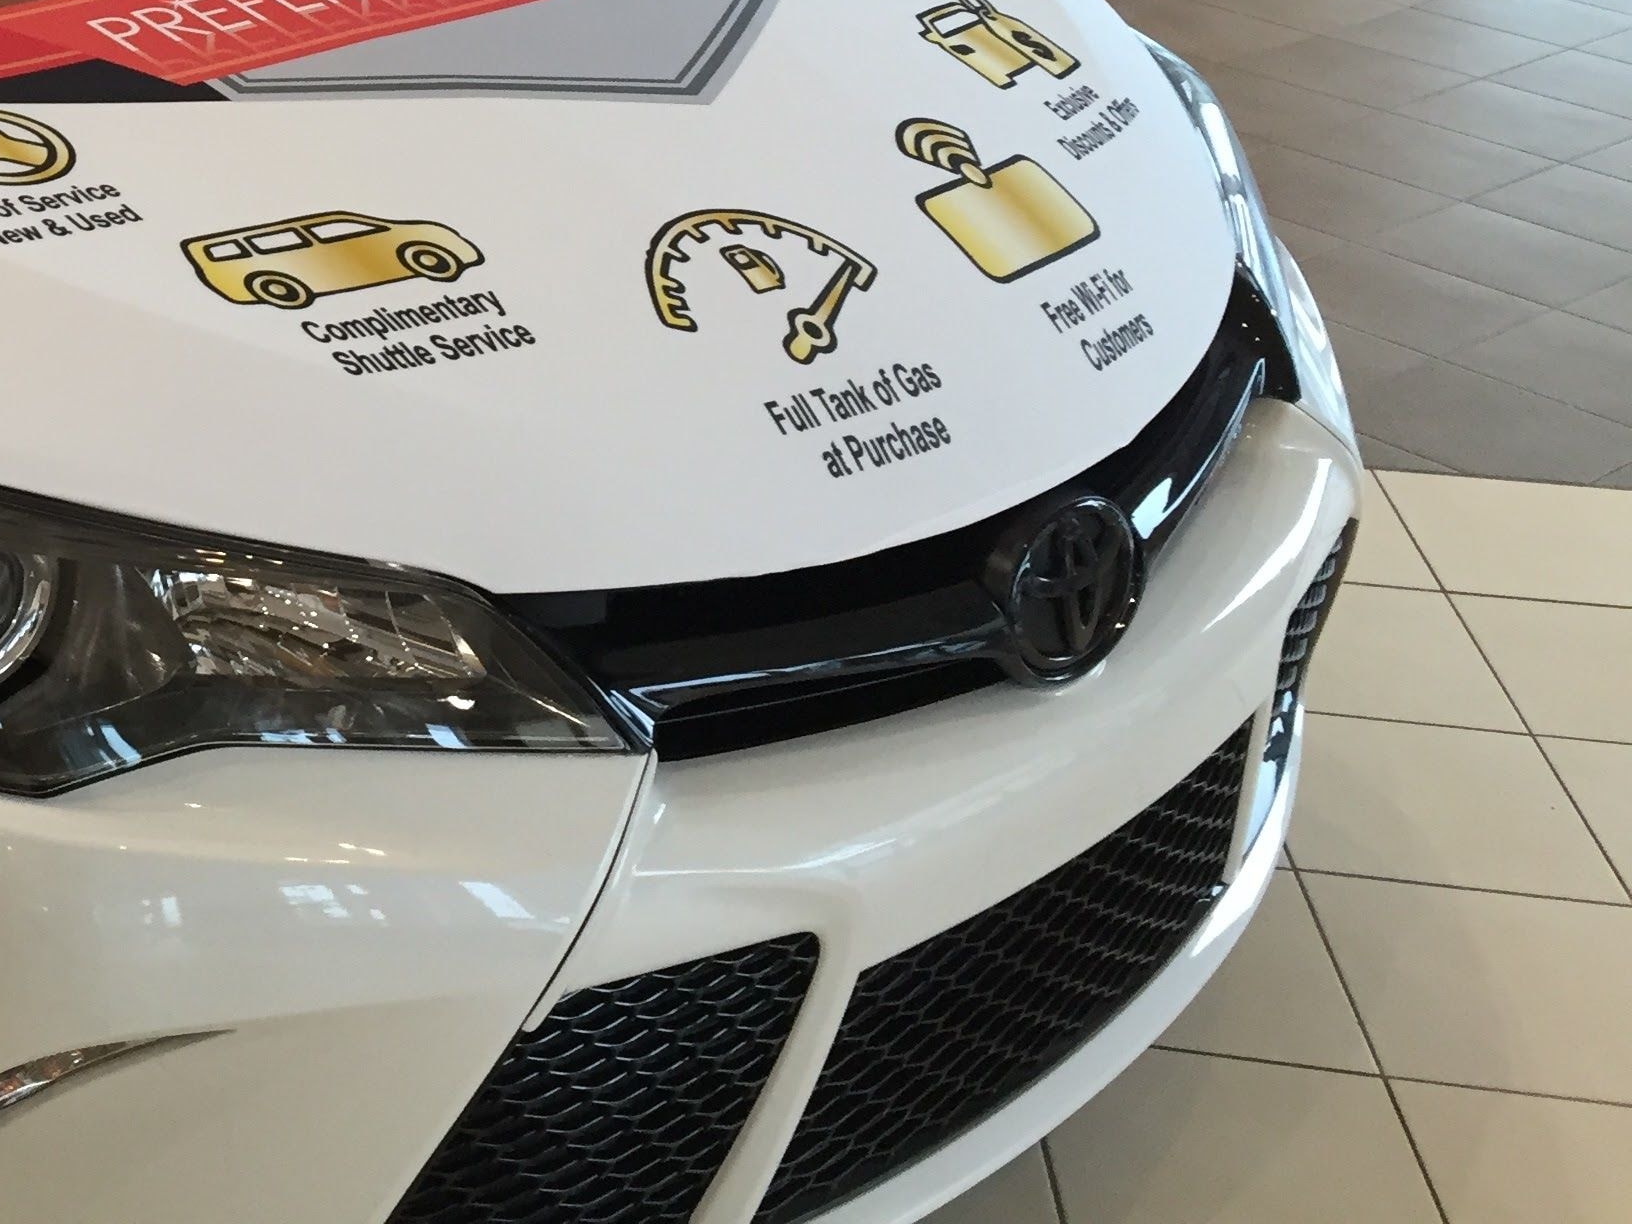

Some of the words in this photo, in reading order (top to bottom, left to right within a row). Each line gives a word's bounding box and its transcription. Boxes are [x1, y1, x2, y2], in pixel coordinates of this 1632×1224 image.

[1043, 85, 1100, 121] Exclusive
[1056, 121, 1116, 161] Discounts
[1098, 111, 1123, 133] &
[18, 182, 121, 214] Service
[47, 218, 73, 236] &
[69, 204, 143, 232] Used
[301, 291, 507, 344] Complimentary
[1040, 301, 1086, 334] Free
[1070, 273, 1119, 316] Wi-Fi
[1103, 268, 1134, 297] for
[332, 342, 437, 376] Shuttle
[430, 323, 536, 361] Service
[1080, 314, 1154, 371] Customers
[763, 392, 823, 436] Full
[809, 379, 879, 423] Tank
[872, 368, 902, 406] of
[892, 363, 943, 398] Gas
[822, 441, 854, 479] at
[842, 416, 952, 472] Purchase
